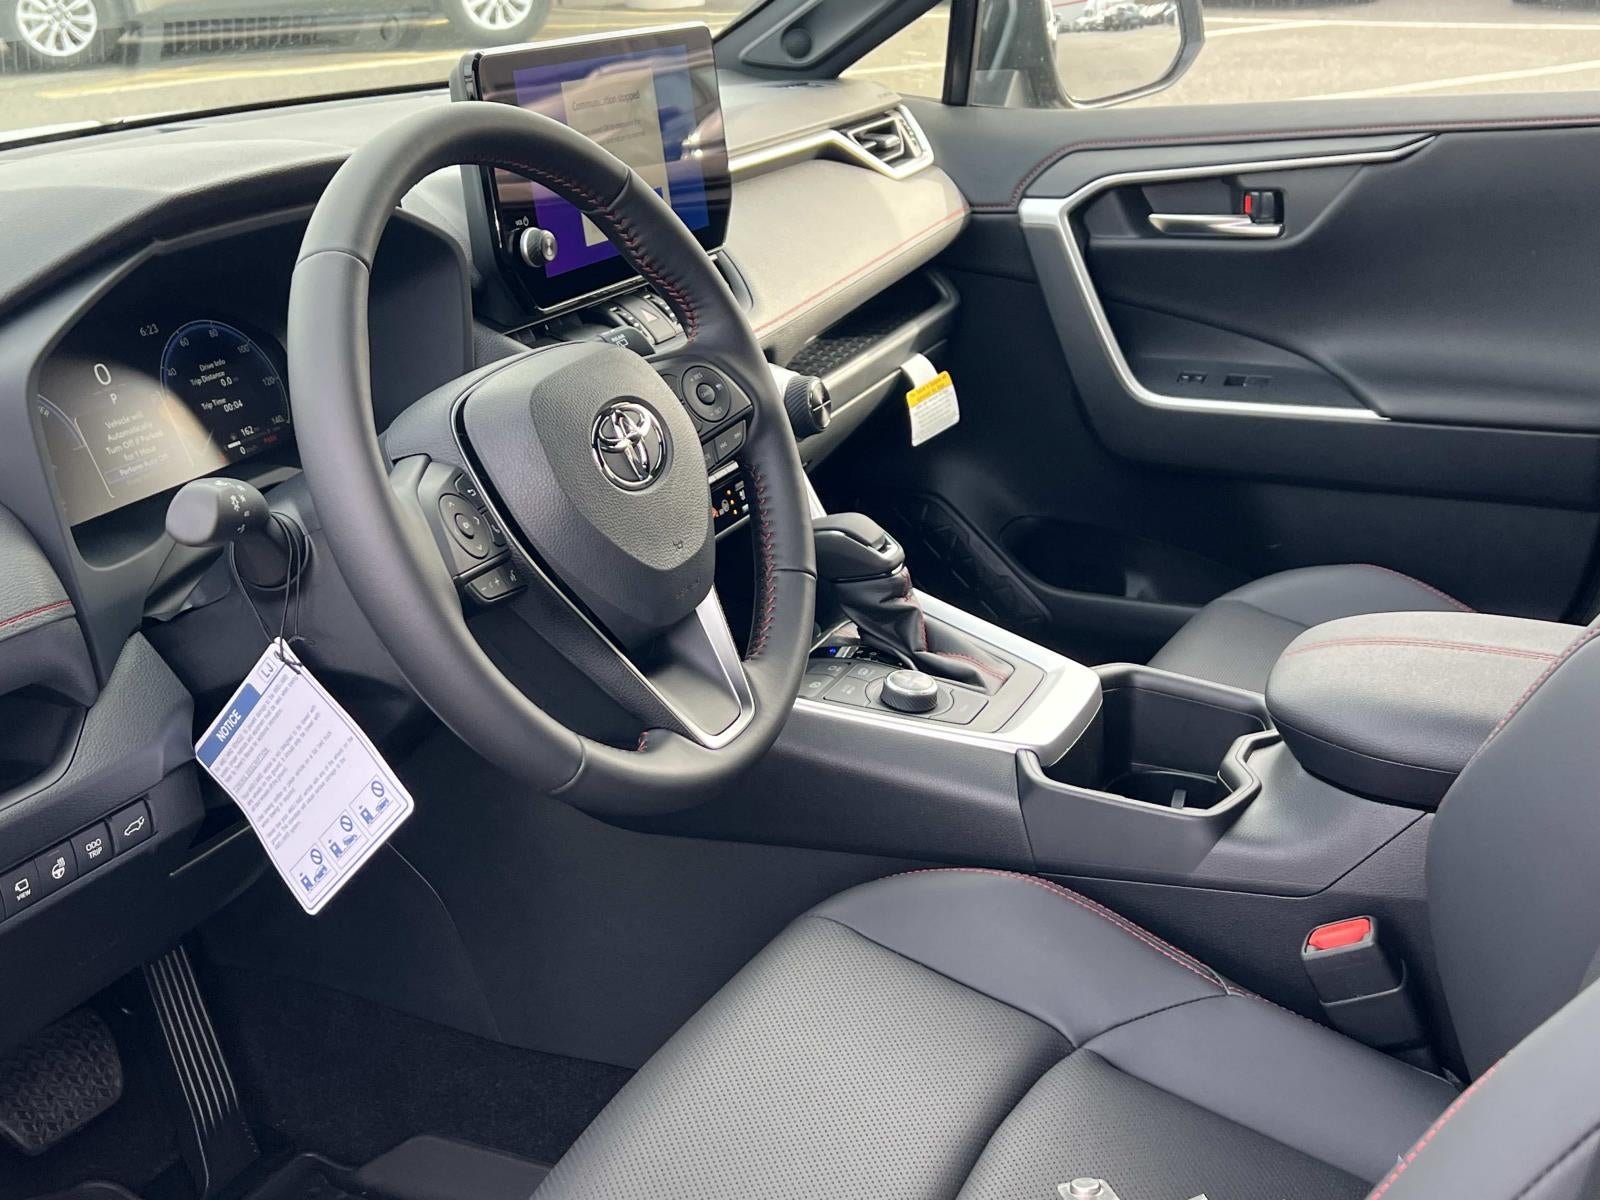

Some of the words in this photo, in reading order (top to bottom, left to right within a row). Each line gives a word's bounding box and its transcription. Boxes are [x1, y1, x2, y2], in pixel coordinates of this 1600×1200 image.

[140, 324, 159, 337] 6:23
[209, 328, 219, 338] 80
[180, 337, 190, 348] 60
[237, 344, 250, 354] 100
[199, 362, 214, 372] Drive
[213, 359, 226, 367] Info
[94, 363, 111, 386] 0
[190, 378, 201, 387] Trip
[201, 371, 225, 383] Distance
[110, 393, 118, 404] P
[201, 401, 213, 411] Trip
[212, 398, 226, 407] Time
[223, 400, 243, 412] 00:04
[241, 425, 254, 437] 162
[261, 662, 274, 678] LJ
[215, 709, 242, 743] NOTICE
[85, 838, 102, 852] ODO
[88, 846, 103, 860] TRIP
[16, 888, 31, 901] VIEW
